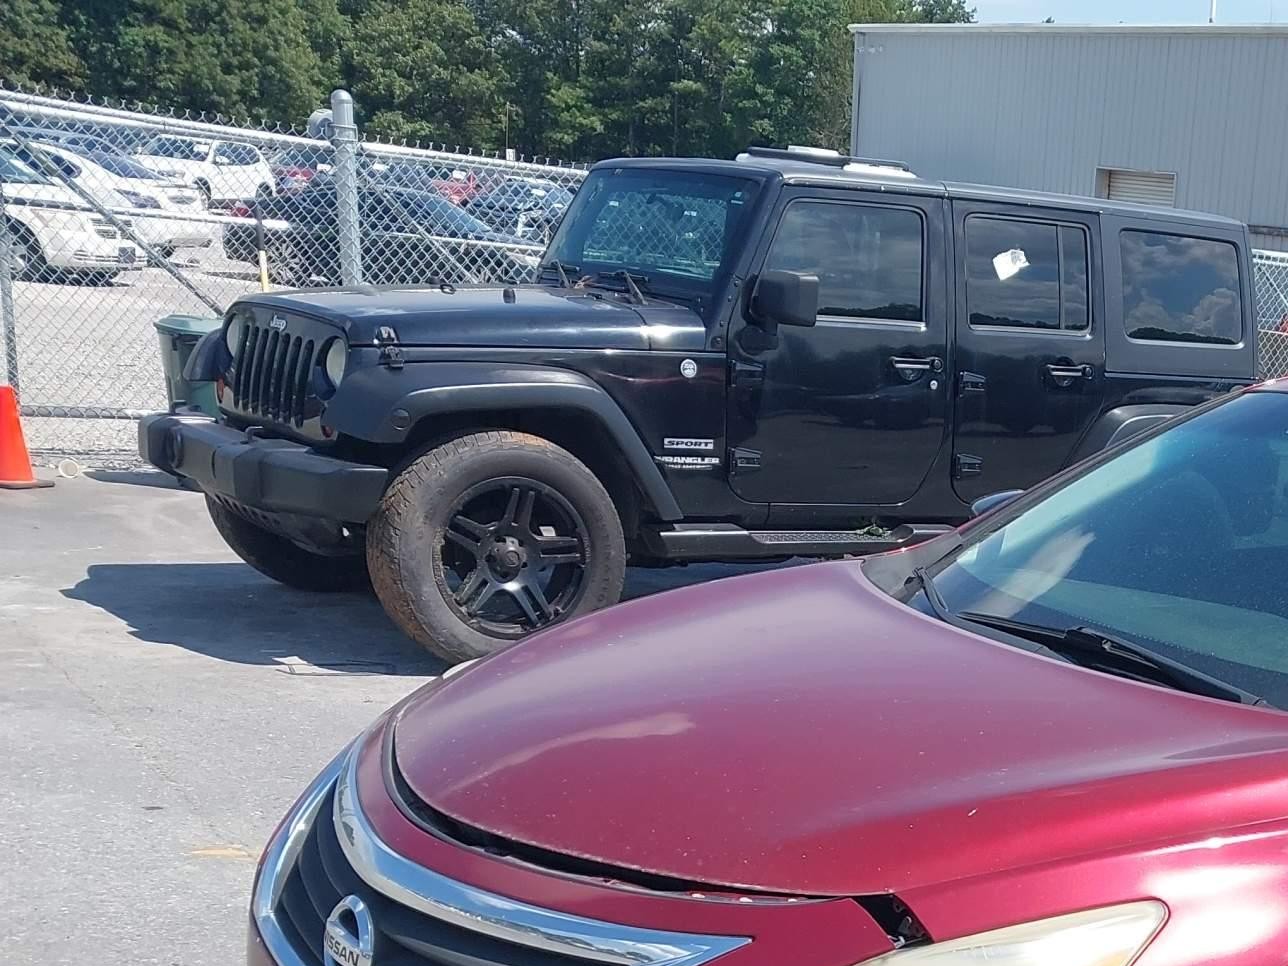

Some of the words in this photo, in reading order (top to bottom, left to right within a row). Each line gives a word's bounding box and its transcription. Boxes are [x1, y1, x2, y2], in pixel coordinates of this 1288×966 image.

[270, 314, 287, 331] Jeep
[666, 440, 713, 448] SPORT
[653, 456, 720, 464] WRANGLER
